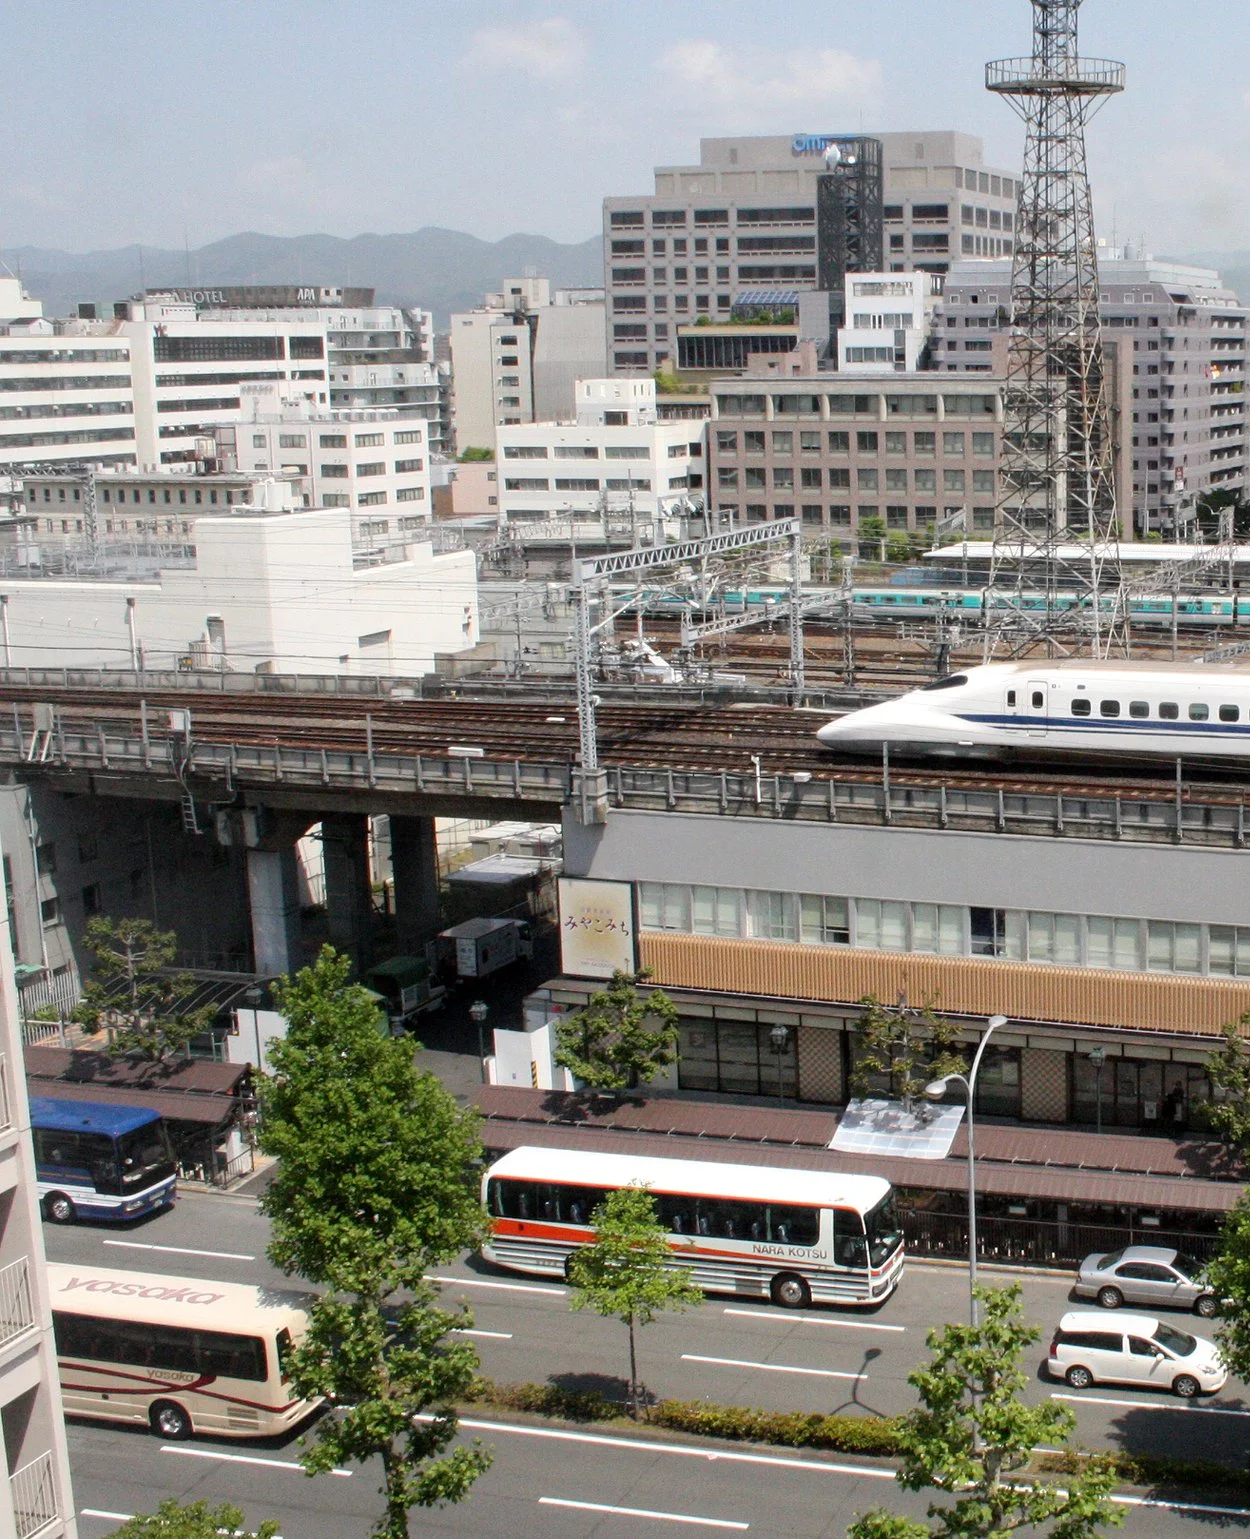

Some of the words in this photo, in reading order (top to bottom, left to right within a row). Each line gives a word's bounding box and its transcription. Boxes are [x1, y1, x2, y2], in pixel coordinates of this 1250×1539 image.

[183, 290, 228, 304] HOTEL
[297, 288, 315, 301] APA
[564, 915, 629, 937] みやこみち
[752, 1244, 785, 1256] NARA
[788, 1247, 828, 1260] KOTSU
[58, 1277, 227, 1305] yasaka
[147, 1369, 195, 1382] yasaka
